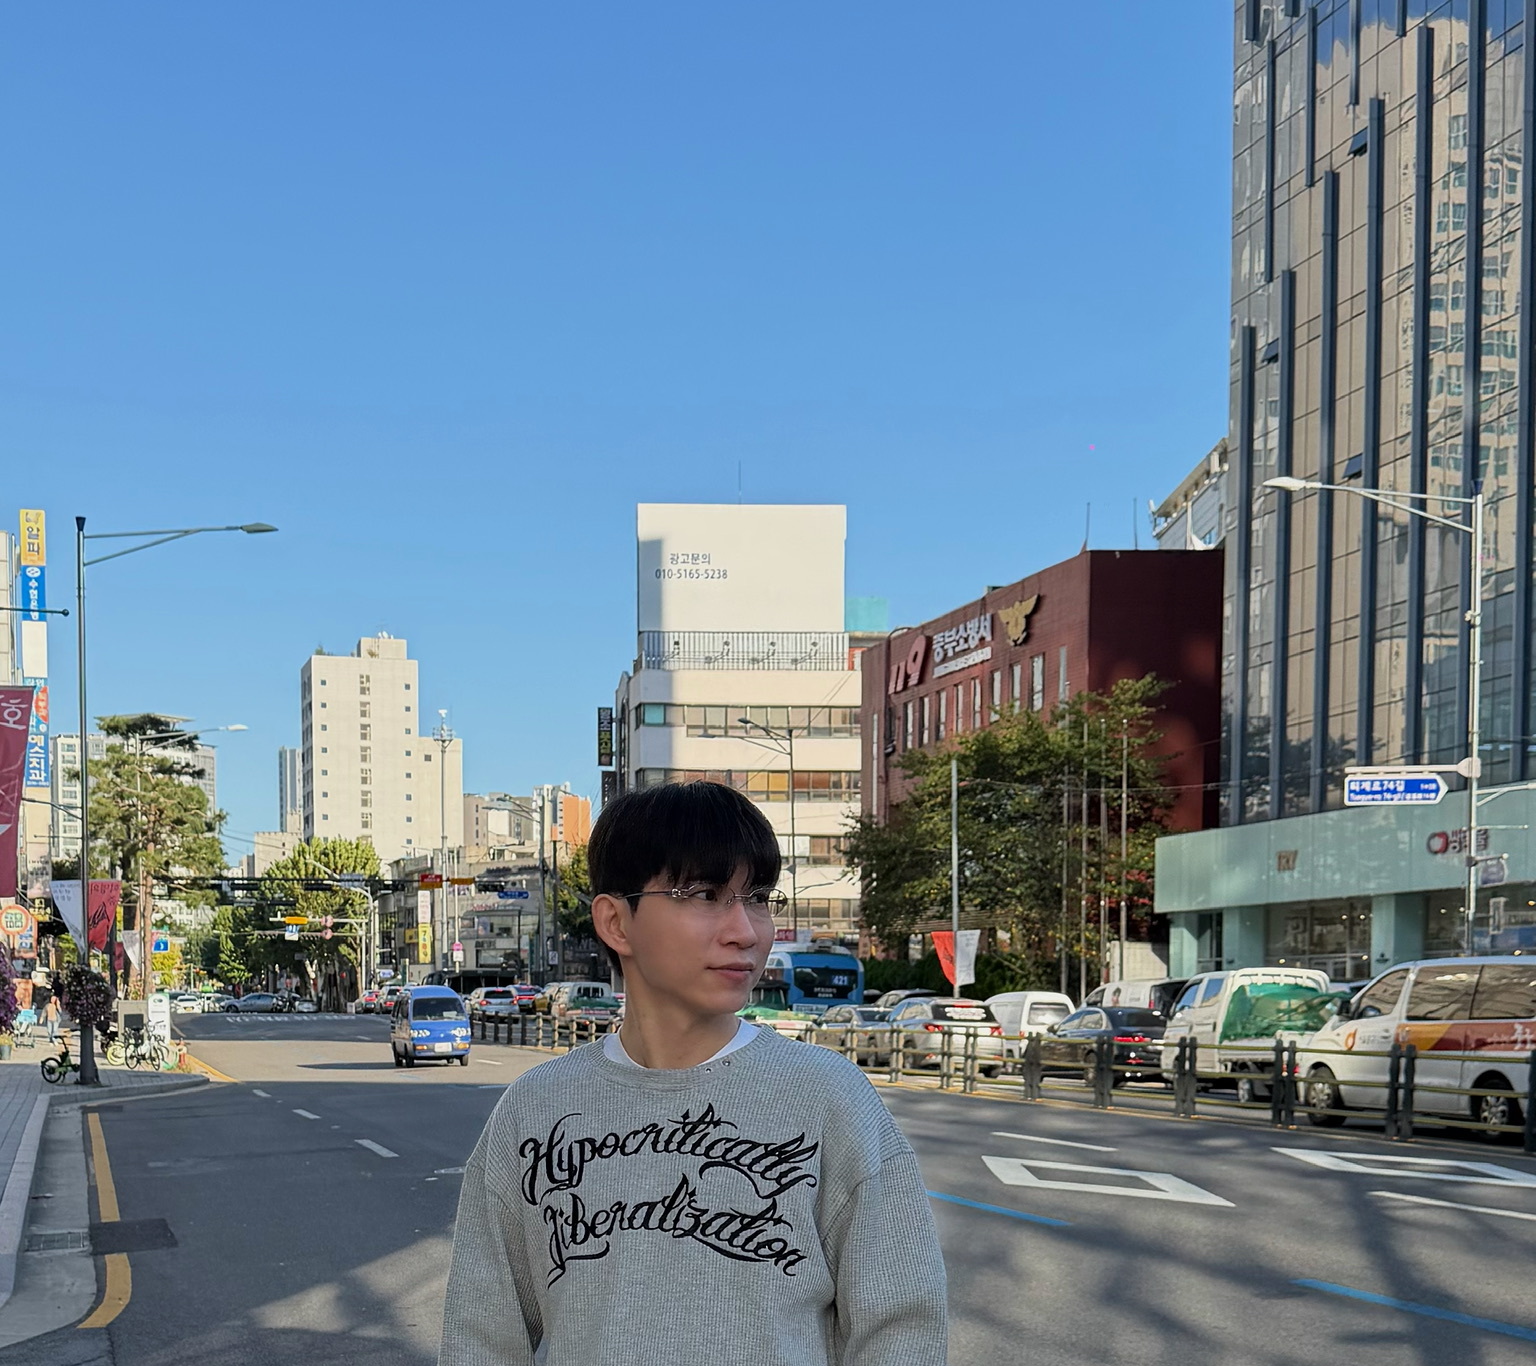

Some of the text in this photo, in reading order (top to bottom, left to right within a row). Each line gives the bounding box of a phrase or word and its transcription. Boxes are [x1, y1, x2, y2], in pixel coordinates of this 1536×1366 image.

[27, 526, 40, 555] 알파
[670, 553, 711, 565] 광고문의
[655, 569, 728, 579] 010-5165-5238
[932, 612, 992, 663] 중부소방서
[888, 634, 926, 695] 119
[833, 975, 848, 985] 421
[519, 1102, 818, 1206] Hypocritically
[544, 1172, 807, 1290] Liberalization
